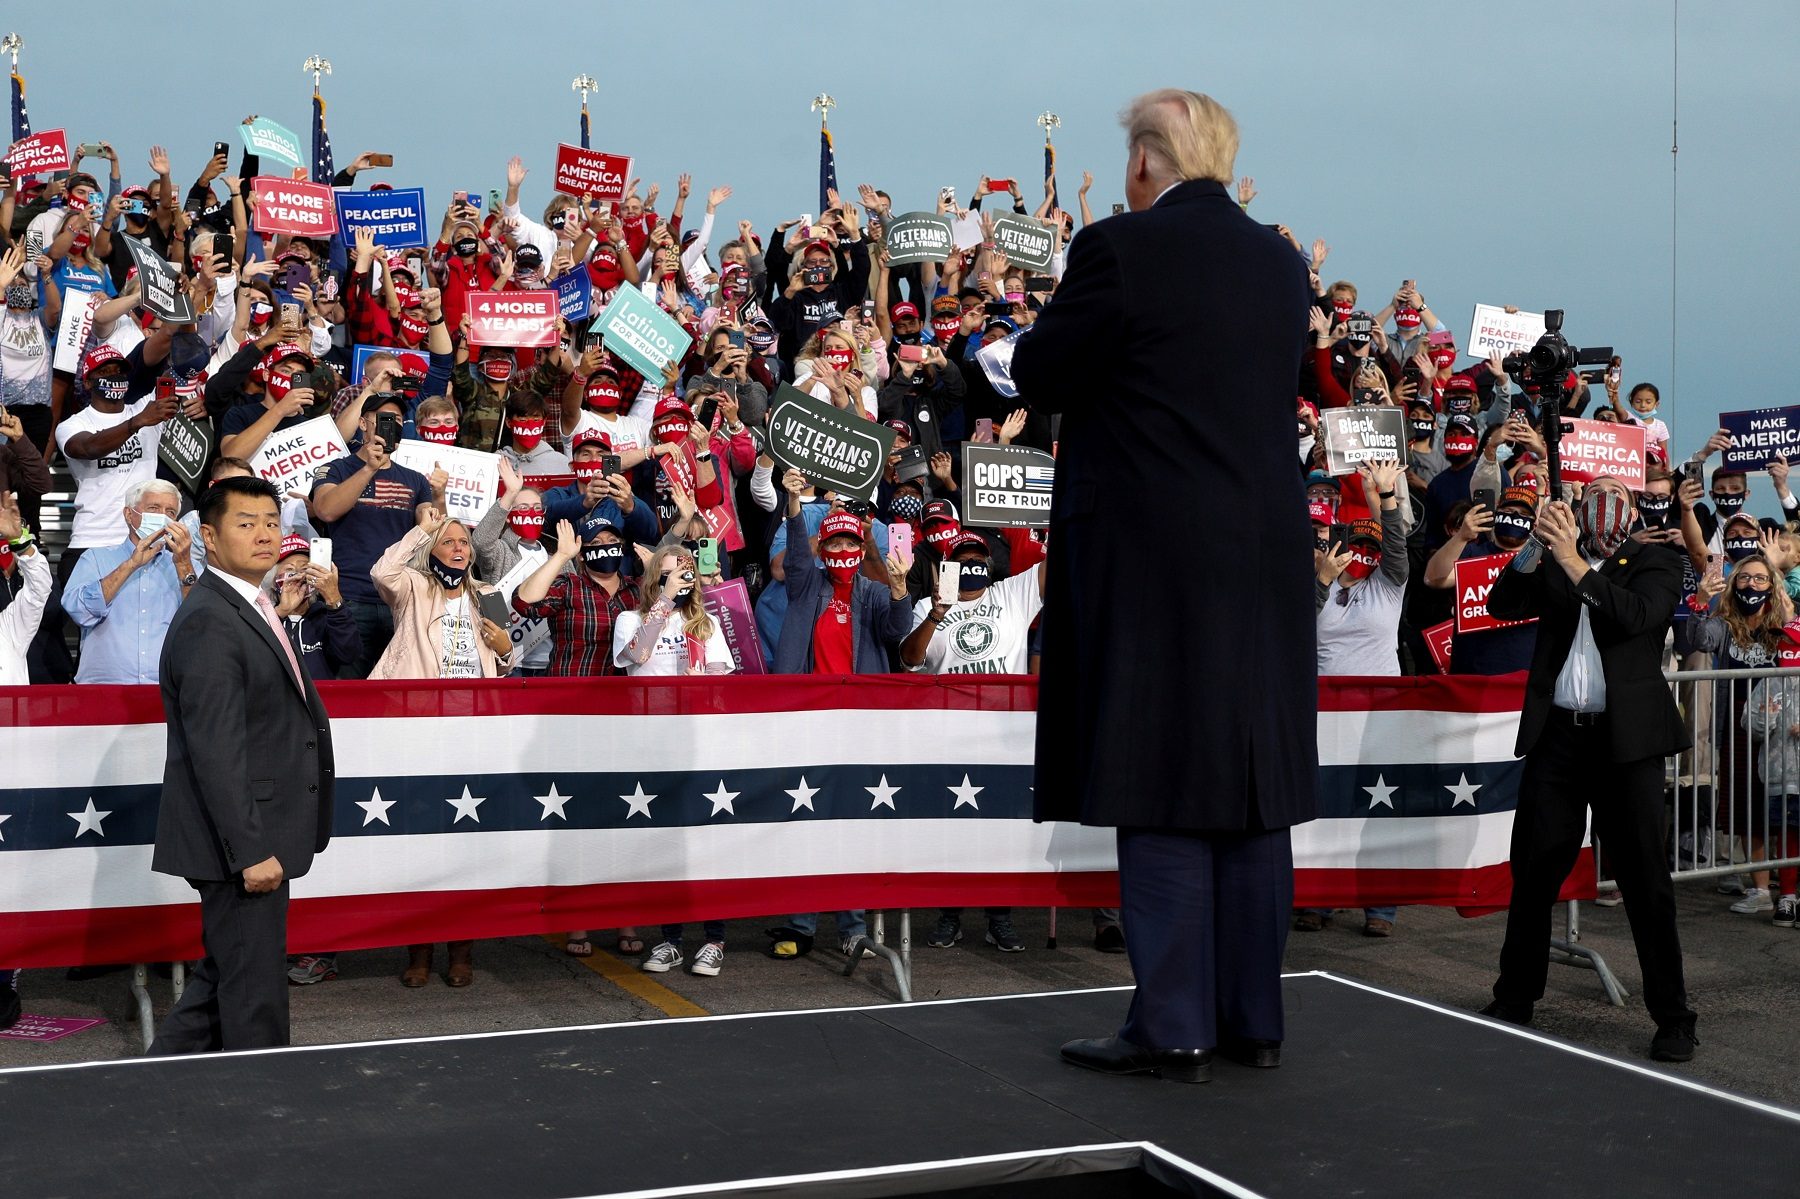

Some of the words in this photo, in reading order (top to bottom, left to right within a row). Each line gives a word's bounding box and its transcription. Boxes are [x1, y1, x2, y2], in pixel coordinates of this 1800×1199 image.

[249, 125, 297, 152] Latinos
[3, 144, 64, 164] MERICA
[11, 138, 42, 155] MAKE
[10, 163, 27, 173] EAT
[30, 155, 66, 168] AGAIN
[577, 156, 607, 170] MAKE
[559, 163, 623, 184] AMERICA
[558, 175, 589, 190] GREAT
[590, 184, 622, 194] AGAIN
[264, 191, 276, 203] 4
[279, 191, 324, 209] MORE
[266, 206, 324, 225] YEARS!
[344, 206, 417, 220] PEACEFUL
[893, 227, 948, 244] VETERANS
[1001, 227, 1049, 252] VETERANS
[517, 247, 538, 257] TRUMP
[899, 241, 916, 249] FOR
[917, 240, 943, 249] TRUMP
[1003, 242, 1018, 251] FOR
[1018, 244, 1042, 257] TRUMP
[136, 247, 163, 272] Black
[592, 252, 618, 265] MAGA
[154, 268, 176, 296] Voices
[559, 279, 577, 294] TEXT
[149, 288, 160, 300] FOR
[478, 302, 491, 313] 4
[495, 302, 547, 315] MORE
[804, 300, 838, 316] TRUMP
[480, 317, 545, 333] YEARS!
[618, 301, 675, 356] Latinos
[934, 319, 960, 331] MAGA
[1483, 316, 1511, 328] THIS
[67, 315, 80, 348] MAKE
[27, 345, 44, 357] 2020
[612, 321, 632, 340] FOR
[633, 337, 665, 366] TRUMP
[271, 375, 291, 390] MA
[588, 387, 620, 399] MAGA
[512, 426, 544, 437] MAGA
[658, 423, 689, 434] MAGA
[1338, 416, 1375, 435] Black
[1750, 417, 1787, 431] MAKE
[424, 431, 457, 441] MAGA
[581, 429, 604, 441] USA
[784, 416, 873, 469] VETERANS
[1360, 431, 1397, 448] Voices
[1578, 429, 1617, 445] MAKE
[171, 435, 194, 463] TRUMP
[264, 436, 307, 461] MAKE
[1445, 442, 1473, 451] MAGA
[260, 441, 342, 482] MERICA
[787, 440, 810, 459] FOR
[813, 453, 856, 475] TRUMP
[1348, 452, 1368, 460] FOR
[1371, 450, 1397, 459] TRUMP
[1727, 449, 1770, 462] GREAT
[100, 459, 118, 467] FOR
[1561, 459, 1596, 474] REAT
[1599, 463, 1641, 479] AGAIN
[476, 468, 485, 479] A
[801, 468, 822, 479] 2020
[974, 462, 1024, 490] COPS
[276, 476, 300, 497] EAT
[978, 492, 1007, 505] FOR
[1012, 494, 1051, 507] TRUM
[1714, 498, 1744, 506] MAGA
[656, 505, 679, 520] TRUM
[513, 515, 545, 526] MAGA
[823, 516, 840, 526] MAKE
[838, 514, 860, 528] AMERICA
[826, 522, 843, 533] GREAT
[842, 522, 858, 533] AGAIN
[1495, 514, 1532, 531] MAGA
[927, 527, 958, 543] MAGA
[948, 534, 964, 546] MAKE
[962, 532, 984, 544] AMERICA
[1726, 540, 1759, 550] MAGA
[586, 547, 624, 562] MAGA
[825, 555, 861, 568] MAGA
[1352, 552, 1380, 567] AGA
[960, 565, 988, 577] AGA
[1680, 554, 1697, 591] VOICES
[935, 603, 1003, 632] UNIVERSITY
[1462, 605, 1489, 619] GRE
[720, 604, 737, 645] TRUMP
[749, 625, 757, 640] 2020
[656, 643, 688, 651] PEN
[731, 646, 745, 671] FOR
